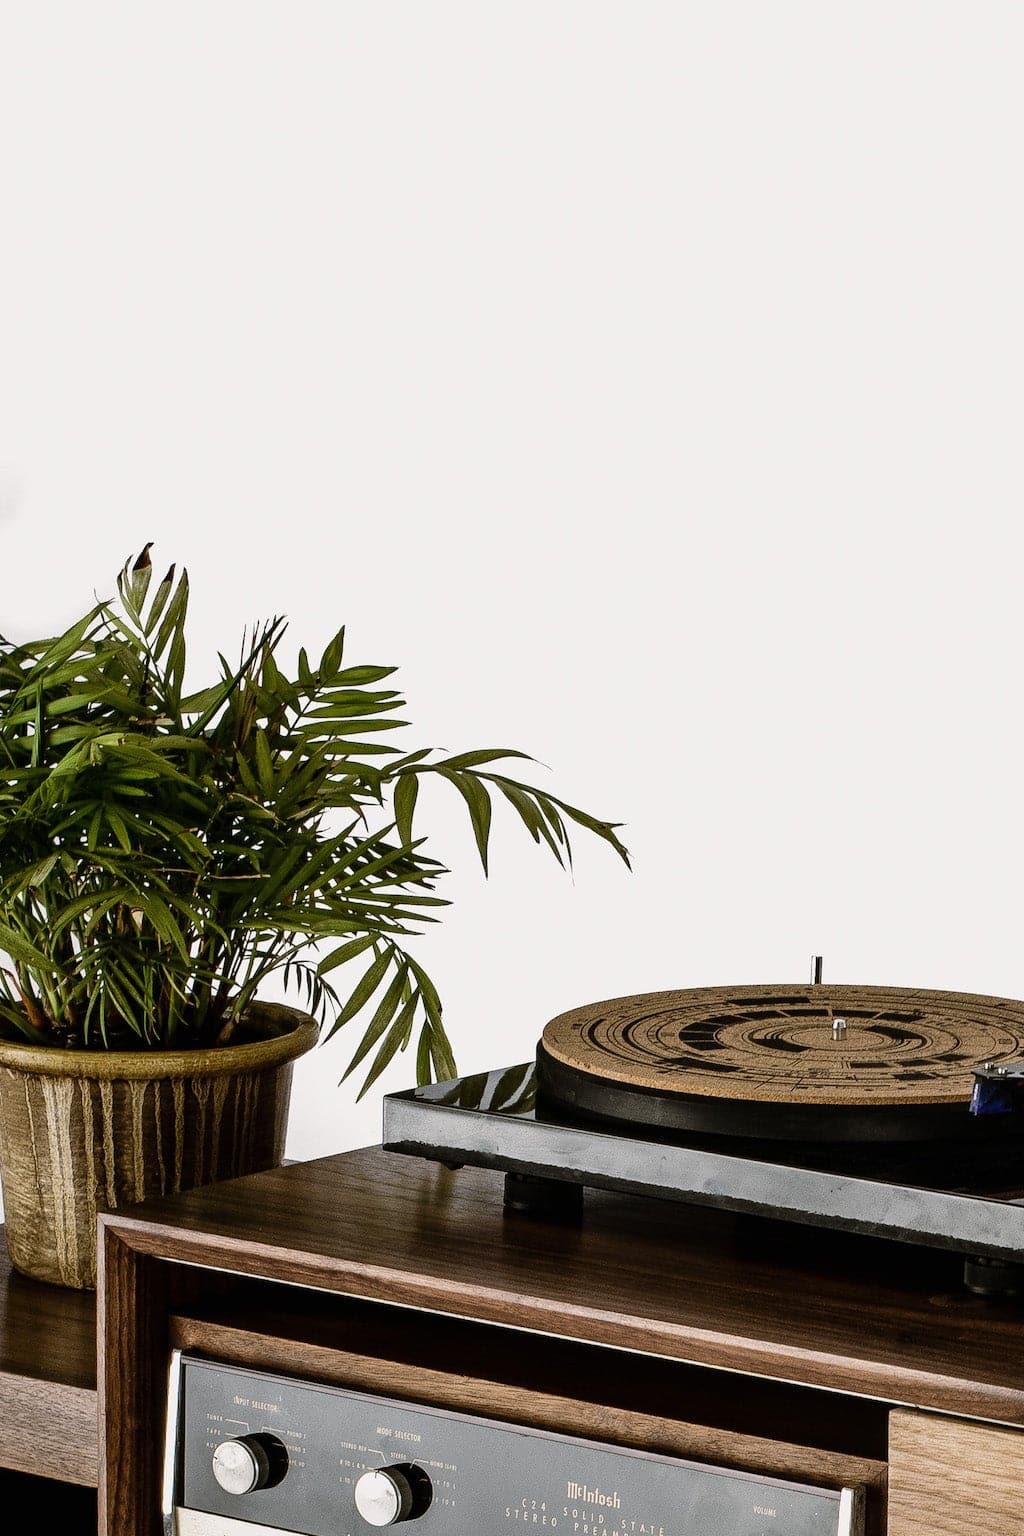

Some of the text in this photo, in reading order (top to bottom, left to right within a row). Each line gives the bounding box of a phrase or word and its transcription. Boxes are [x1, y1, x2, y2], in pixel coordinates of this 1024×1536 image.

[233, 1395, 280, 1412] INPUT SELECTOR
[376, 1426, 421, 1442] MODE SELECTOR
[390, 1452, 406, 1460] STEREO
[567, 1481, 621, 1509] McIntosh
[505, 1508, 557, 1527] STEREO
[753, 1505, 777, 1517] VOLUME
[563, 1507, 604, 1524] SOLID
[622, 1520, 664, 1536] STATE
